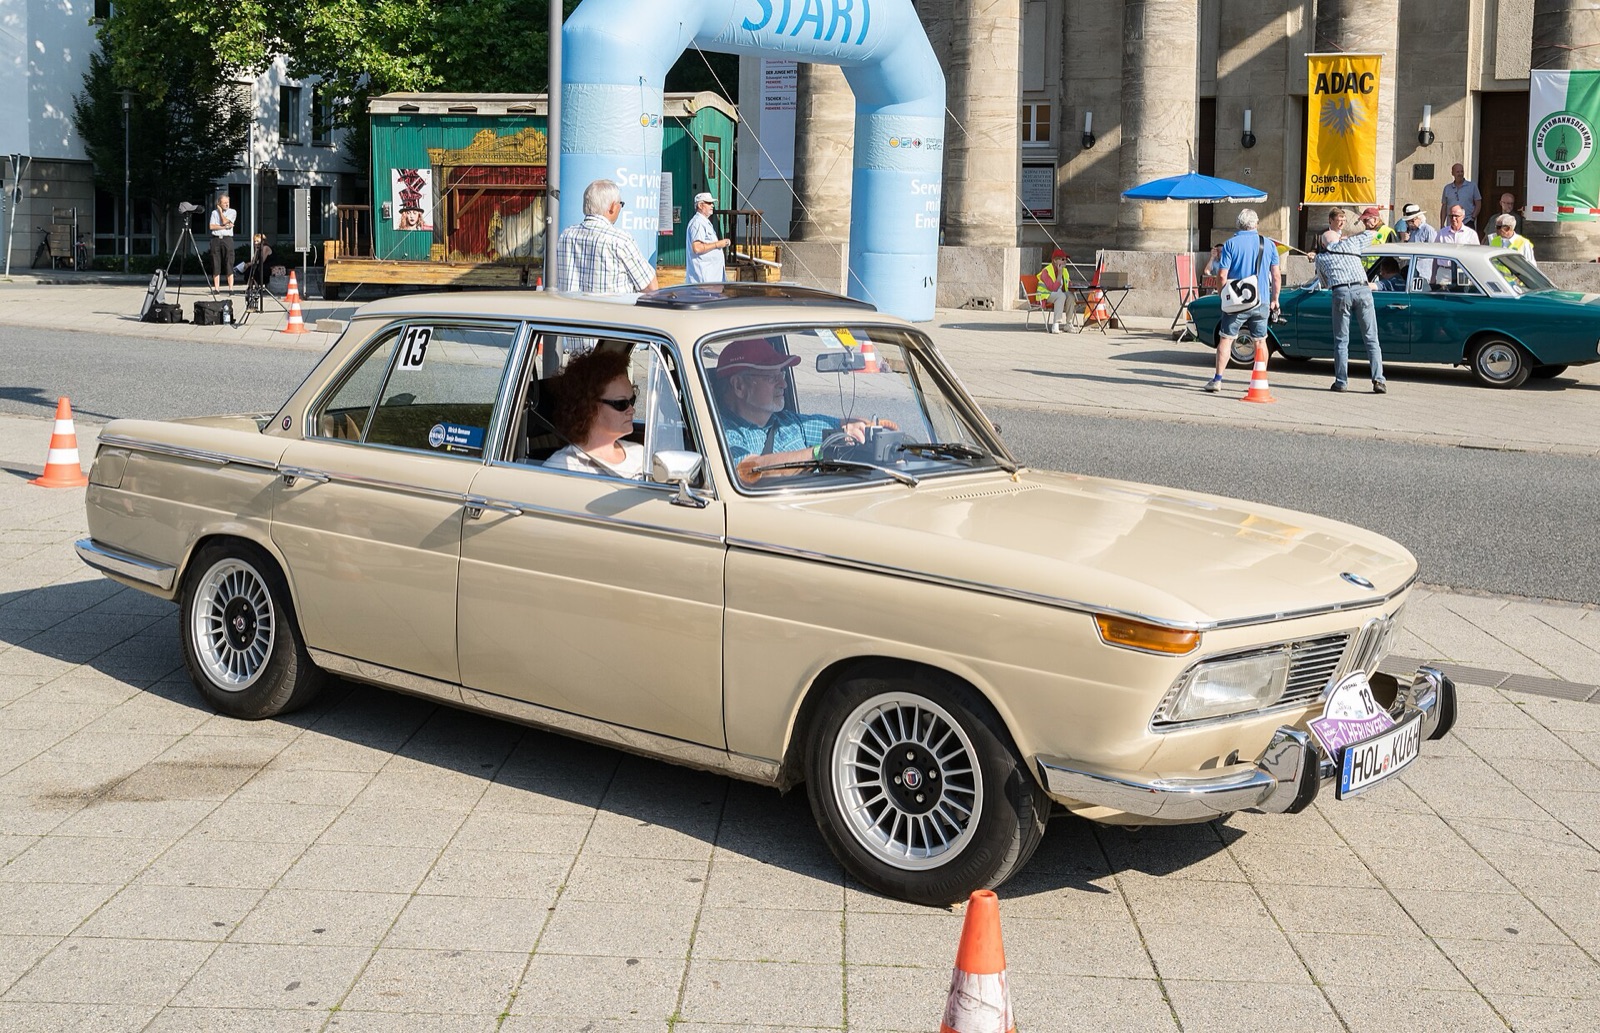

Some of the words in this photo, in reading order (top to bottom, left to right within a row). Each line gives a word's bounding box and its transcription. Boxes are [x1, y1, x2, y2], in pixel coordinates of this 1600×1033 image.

[1314, 72, 1374, 95] ADAC
[1541, 116, 1592, 149] HERMANNSDENKMAL
[1555, 162, 1577, 172] ADAC
[1311, 174, 1371, 184] Ostwestfalen-
[1311, 185, 1335, 195] Lippe
[636, 191, 658, 210] mit
[1230, 279, 1257, 304] 5
[1413, 278, 1424, 291] 10
[402, 328, 432, 367] 13
[1359, 688, 1375, 716] 13
[1351, 744, 1383, 785] HOL
